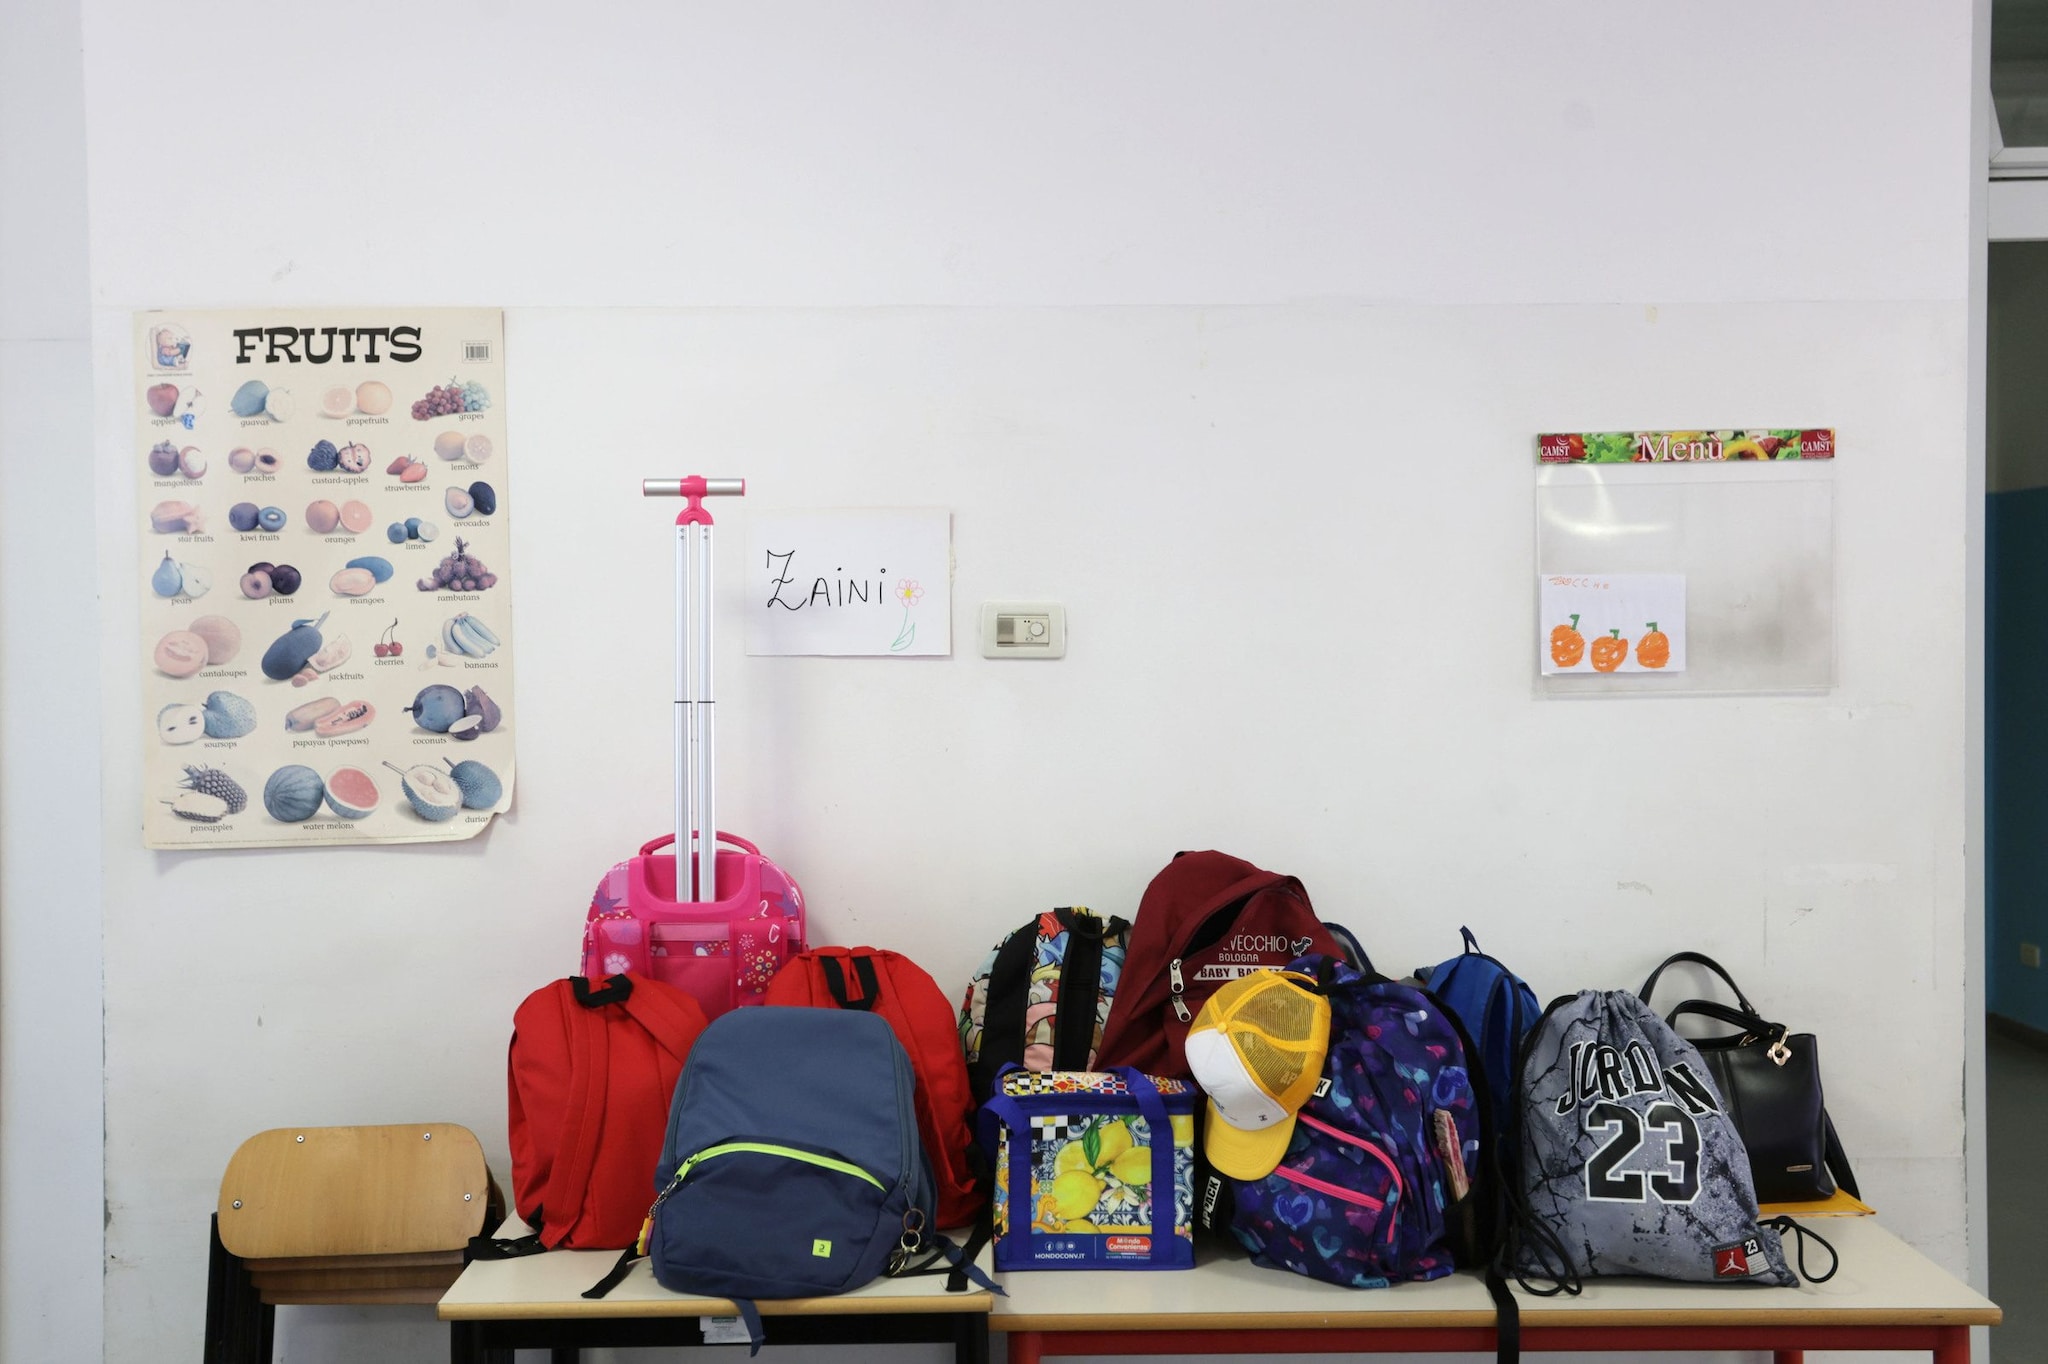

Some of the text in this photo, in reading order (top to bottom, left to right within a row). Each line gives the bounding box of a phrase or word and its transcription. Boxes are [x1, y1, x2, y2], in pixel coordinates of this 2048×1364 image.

[233, 326, 422, 364] FRUITS
[458, 412, 484, 421] grapes
[151, 416, 176, 427] apples
[240, 419, 270, 427] guavas
[346, 417, 389, 426] grapefruits
[1639, 433, 1726, 462] Menù
[1800, 440, 1832, 452] CAMST
[1540, 445, 1570, 457] CAMST
[450, 463, 479, 471] lemons
[243, 474, 276, 483] peaches
[311, 476, 369, 485] custard-apples
[154, 479, 203, 488] mangosteens
[384, 484, 431, 492] strawberries
[177, 534, 215, 543] star fruits
[240, 533, 280, 542] kiwi fruits
[324, 536, 356, 544] oranges
[171, 598, 193, 606] pears
[269, 597, 294, 606] plums
[350, 597, 385, 606] mangoes
[437, 593, 480, 602] rambutans
[374, 658, 405, 666] cherries
[464, 660, 499, 669] bananas
[199, 670, 248, 679] cantaloupes
[328, 672, 364, 682] jackfruits
[204, 740, 238, 750] soursops
[293, 737, 370, 749] papayas (pawpaws)
[412, 736, 447, 745] coconuts
[190, 823, 233, 833] pineapples
[303, 820, 355, 831] water melons
[1230, 934, 1288, 953] VECCHIO
[1218, 953, 1260, 963] BOLOGNA
[1200, 967, 1231, 978] BABY
[1585, 1100, 1702, 1205] 23
[1116, 1237, 1141, 1245] Mondo
[1744, 1239, 1759, 1255] 23
